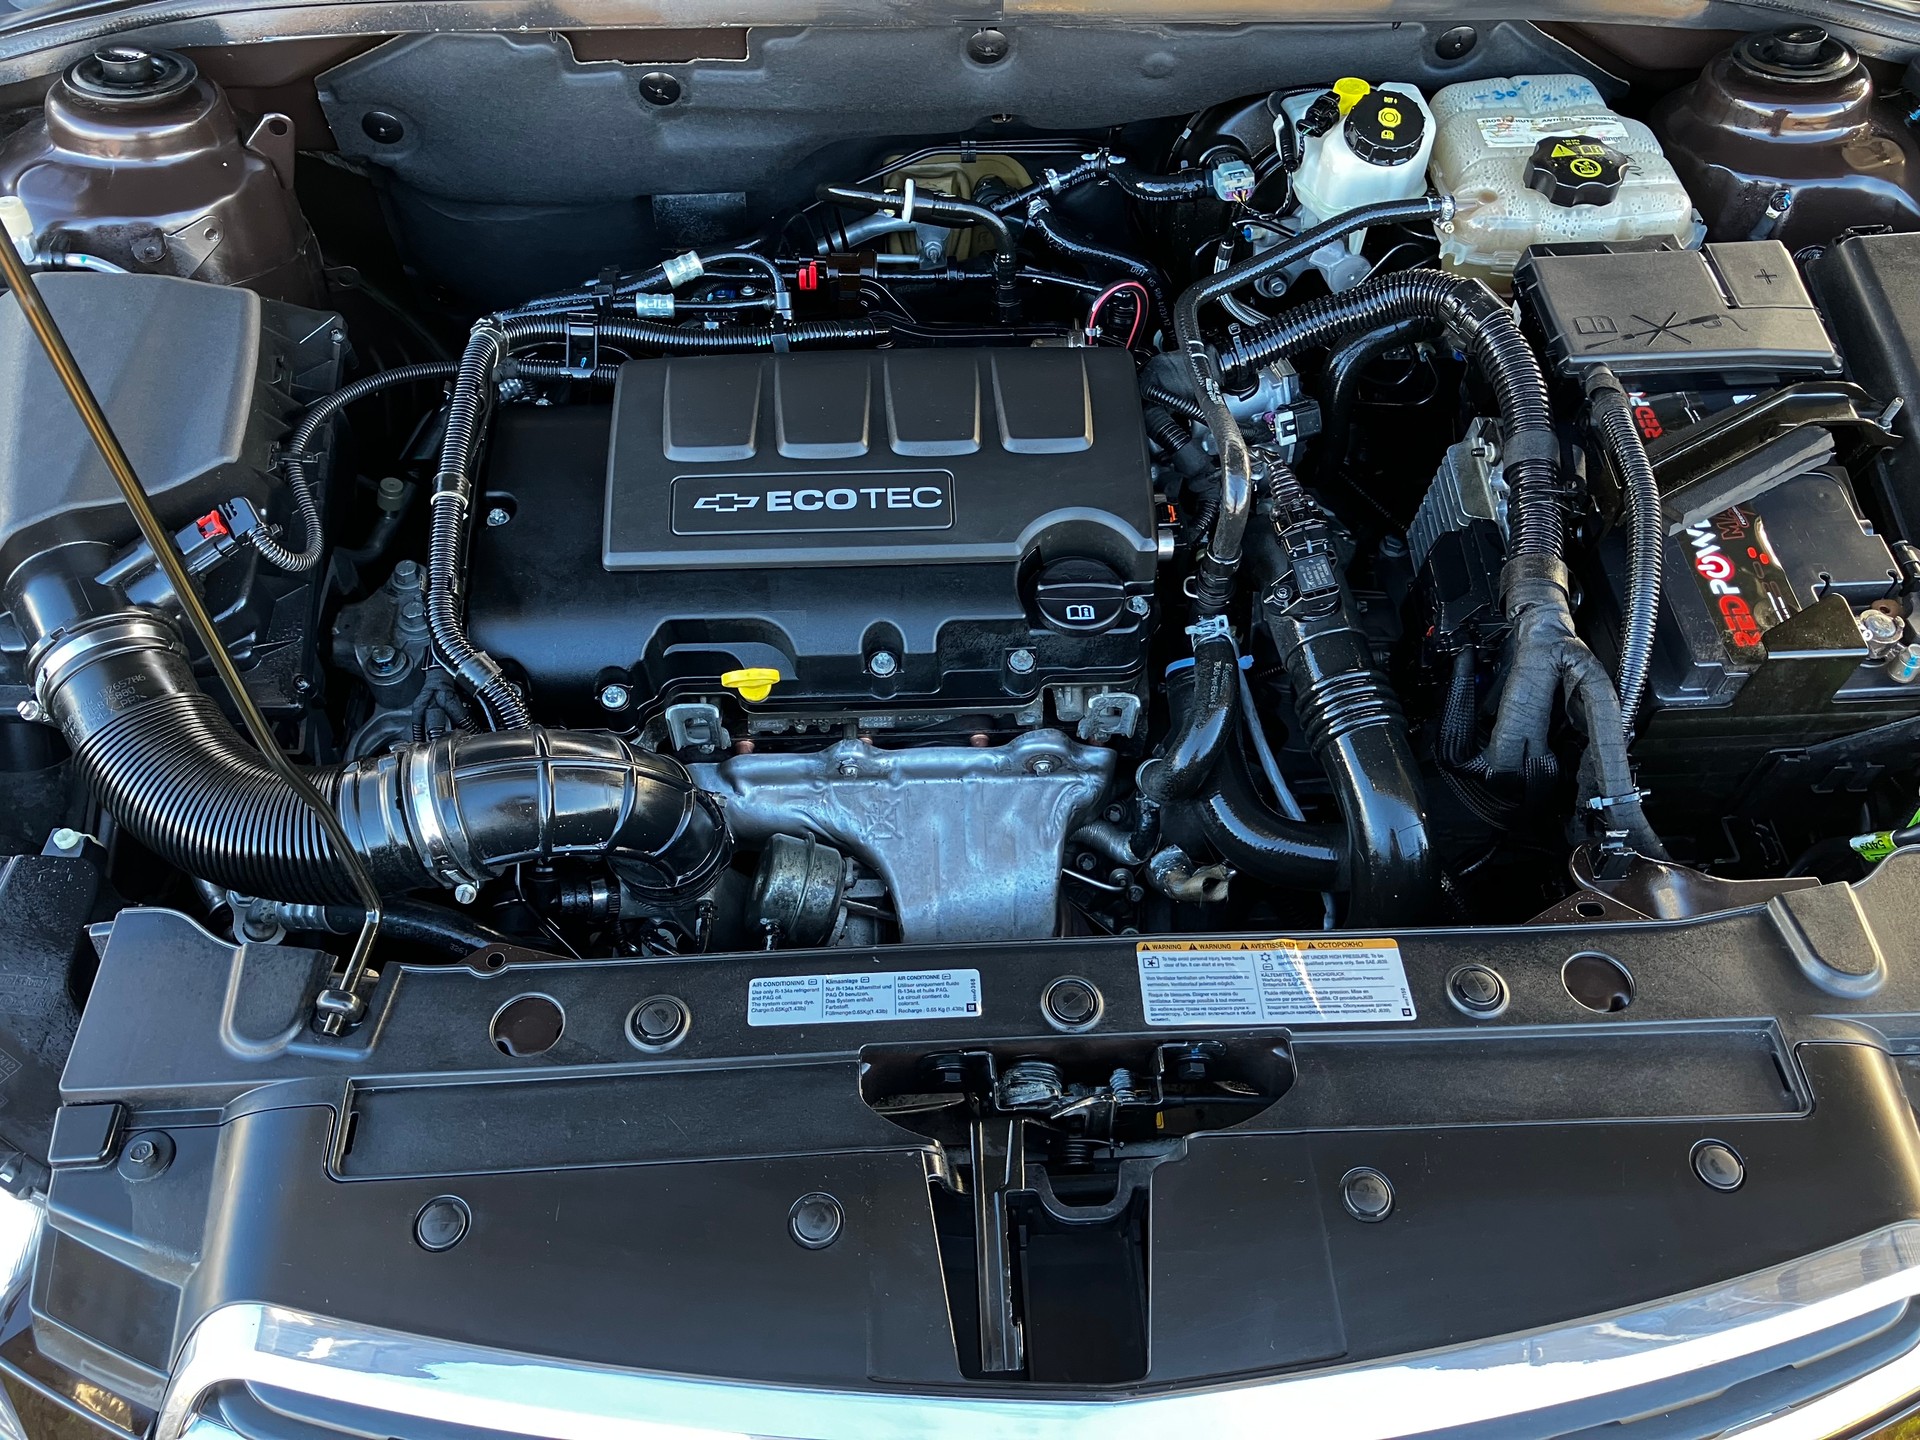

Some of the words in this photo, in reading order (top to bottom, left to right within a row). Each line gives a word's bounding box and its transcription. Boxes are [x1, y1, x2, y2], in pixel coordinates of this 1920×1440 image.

[767, 486, 943, 512] ECOTEC
[1685, 518, 1763, 648] REDPOW
[1317, 940, 1364, 948] ОСТОРОЖНО
